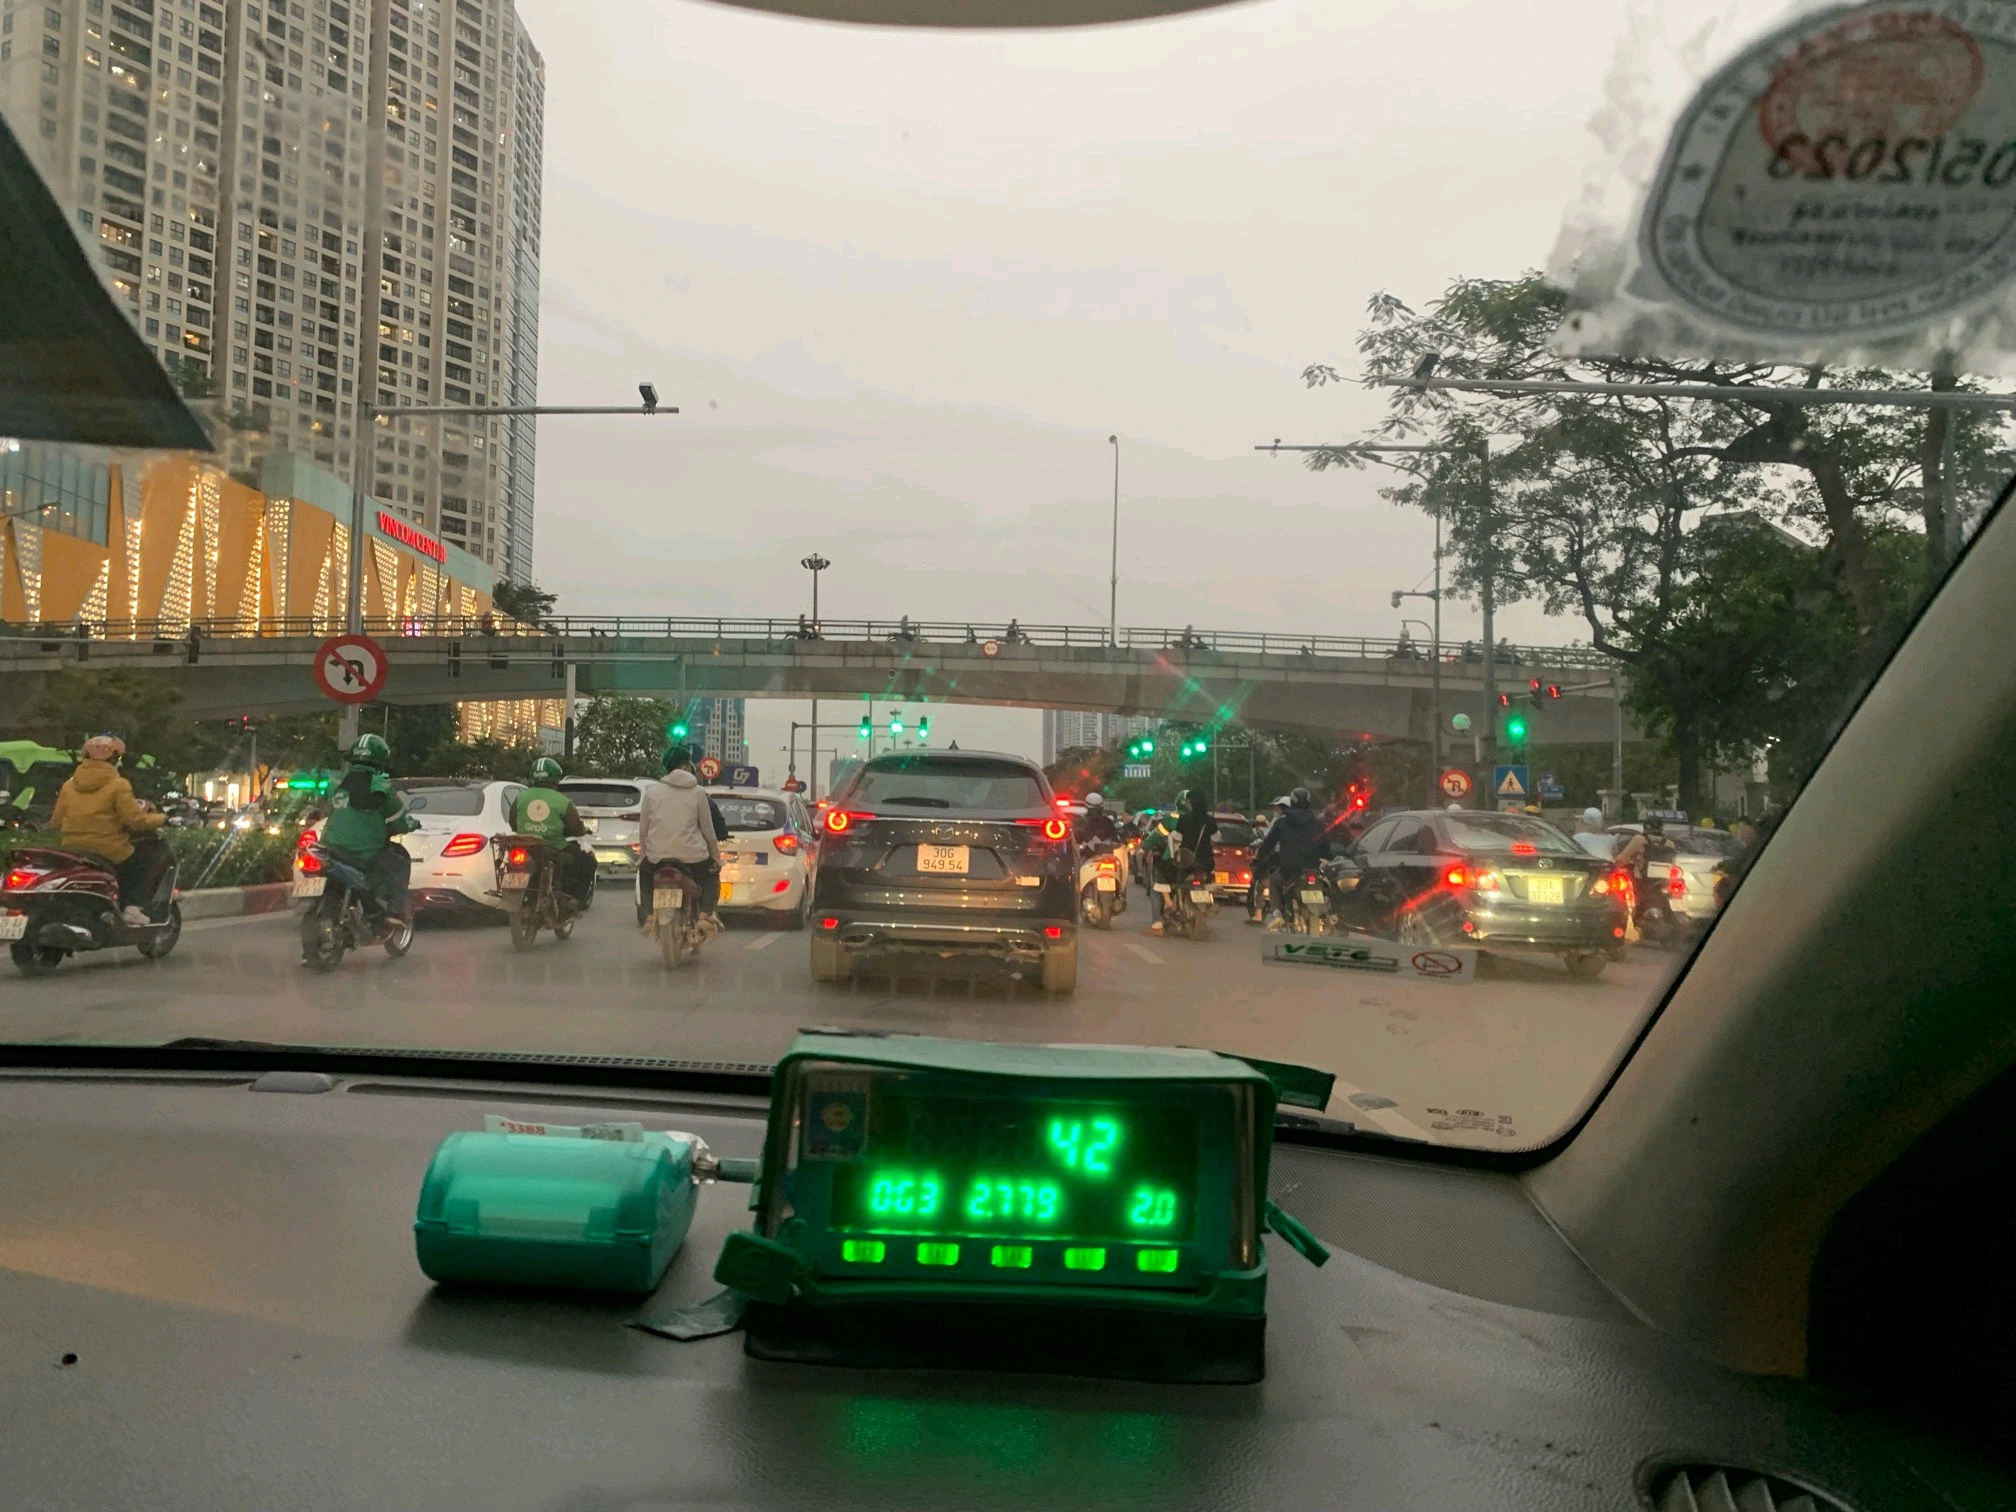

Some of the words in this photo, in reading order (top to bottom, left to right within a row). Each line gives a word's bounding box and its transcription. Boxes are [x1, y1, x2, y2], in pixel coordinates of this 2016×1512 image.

[525, 822, 548, 832] Grab
[933, 848, 955, 858] 30G
[923, 860, 963, 870] 949.54
[1050, 1119, 1118, 1173] 42
[1131, 1190, 1177, 1226] 2.0
